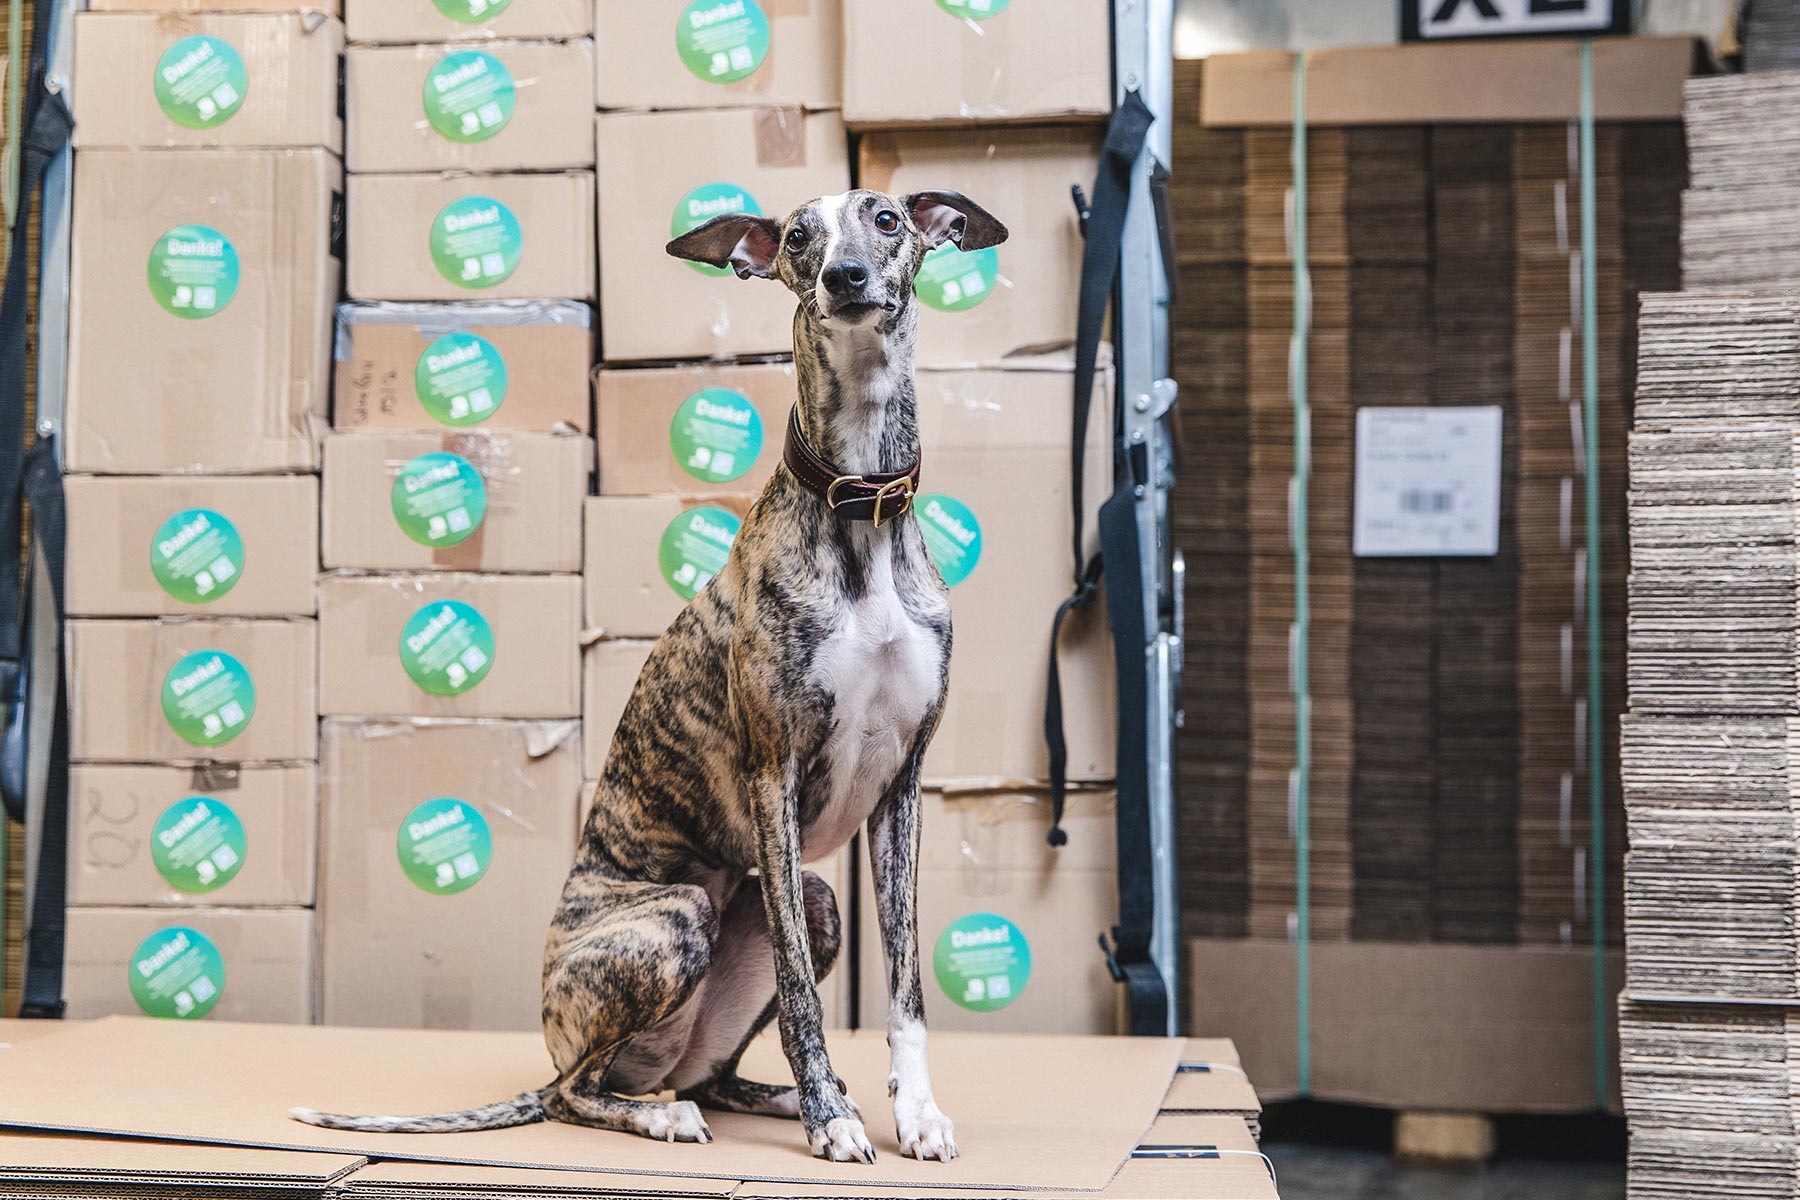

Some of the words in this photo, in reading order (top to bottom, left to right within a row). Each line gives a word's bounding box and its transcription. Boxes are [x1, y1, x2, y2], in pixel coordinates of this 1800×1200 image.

[690, 0, 745, 28] Danke!
[162, 41, 214, 84] Danke!
[433, 56, 488, 92] Danke!
[444, 204, 500, 232] Danke!
[688, 194, 744, 217] Danke!
[168, 238, 223, 257] Danke!
[427, 340, 482, 373] Danke!
[695, 398, 751, 427] Danke!
[404, 460, 460, 493] Danke!
[158, 513, 211, 558] Danke!
[925, 500, 976, 547] Danke!
[407, 605, 457, 653] Danke!
[170, 655, 225, 697] Danke!
[158, 801, 211, 848] Danke!
[408, 804, 466, 841] Danke!
[951, 924, 1010, 948] Danke!
[137, 931, 190, 978] Danke!
